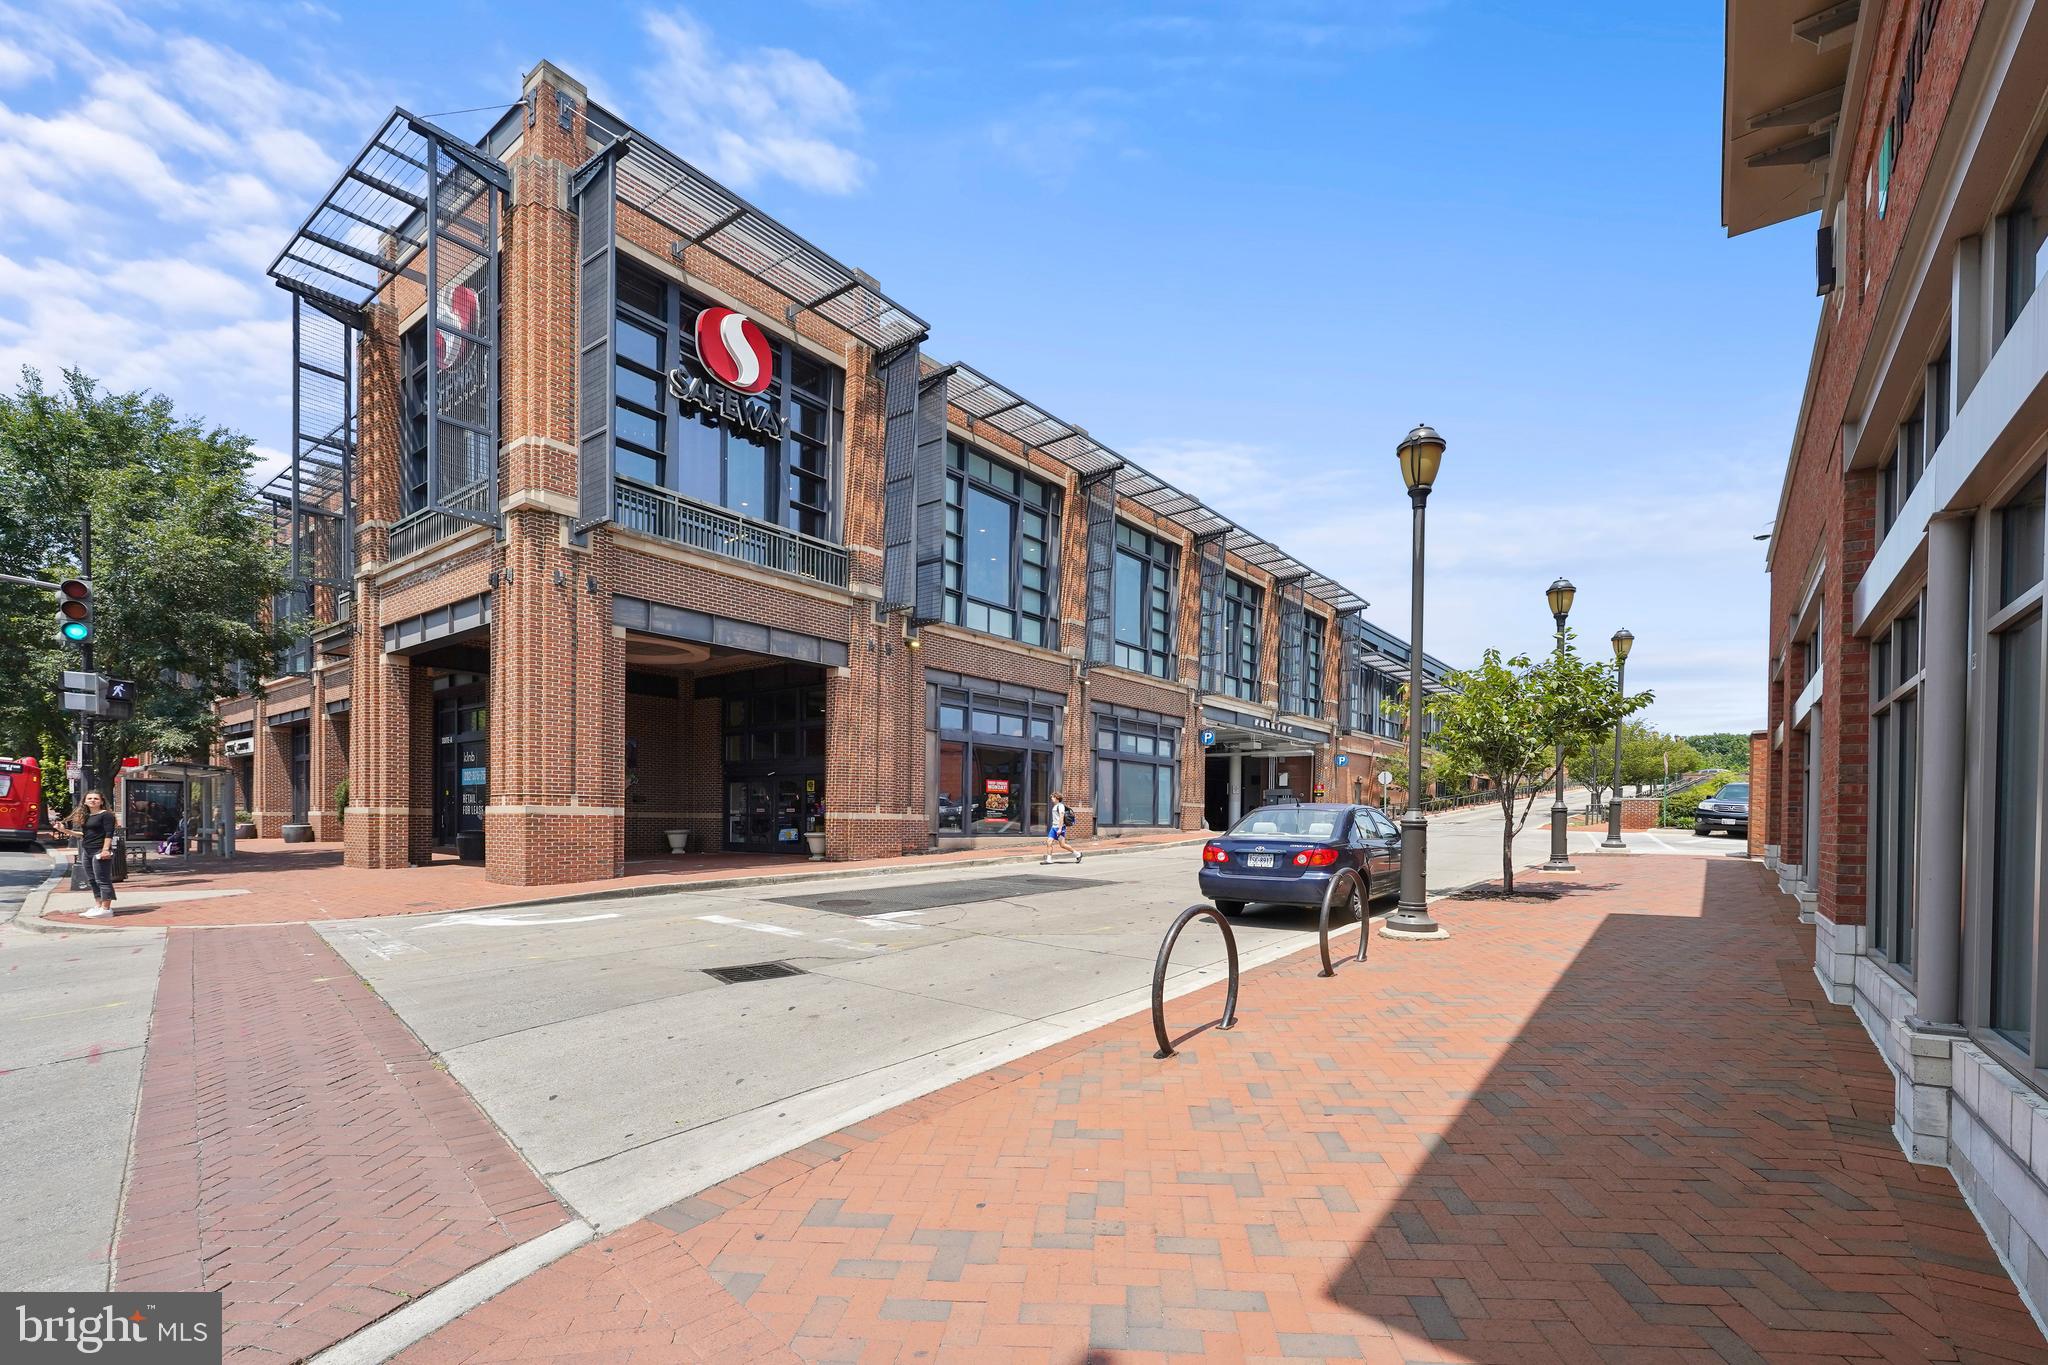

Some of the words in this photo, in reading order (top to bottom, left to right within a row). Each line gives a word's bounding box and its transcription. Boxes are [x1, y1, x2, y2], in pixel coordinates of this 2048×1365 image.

[668, 368, 789, 440] SAFEWAY
[1253, 718, 1293, 734] PARKING
[463, 794, 476, 804] RETAIL
[463, 806, 471, 814] FOR
